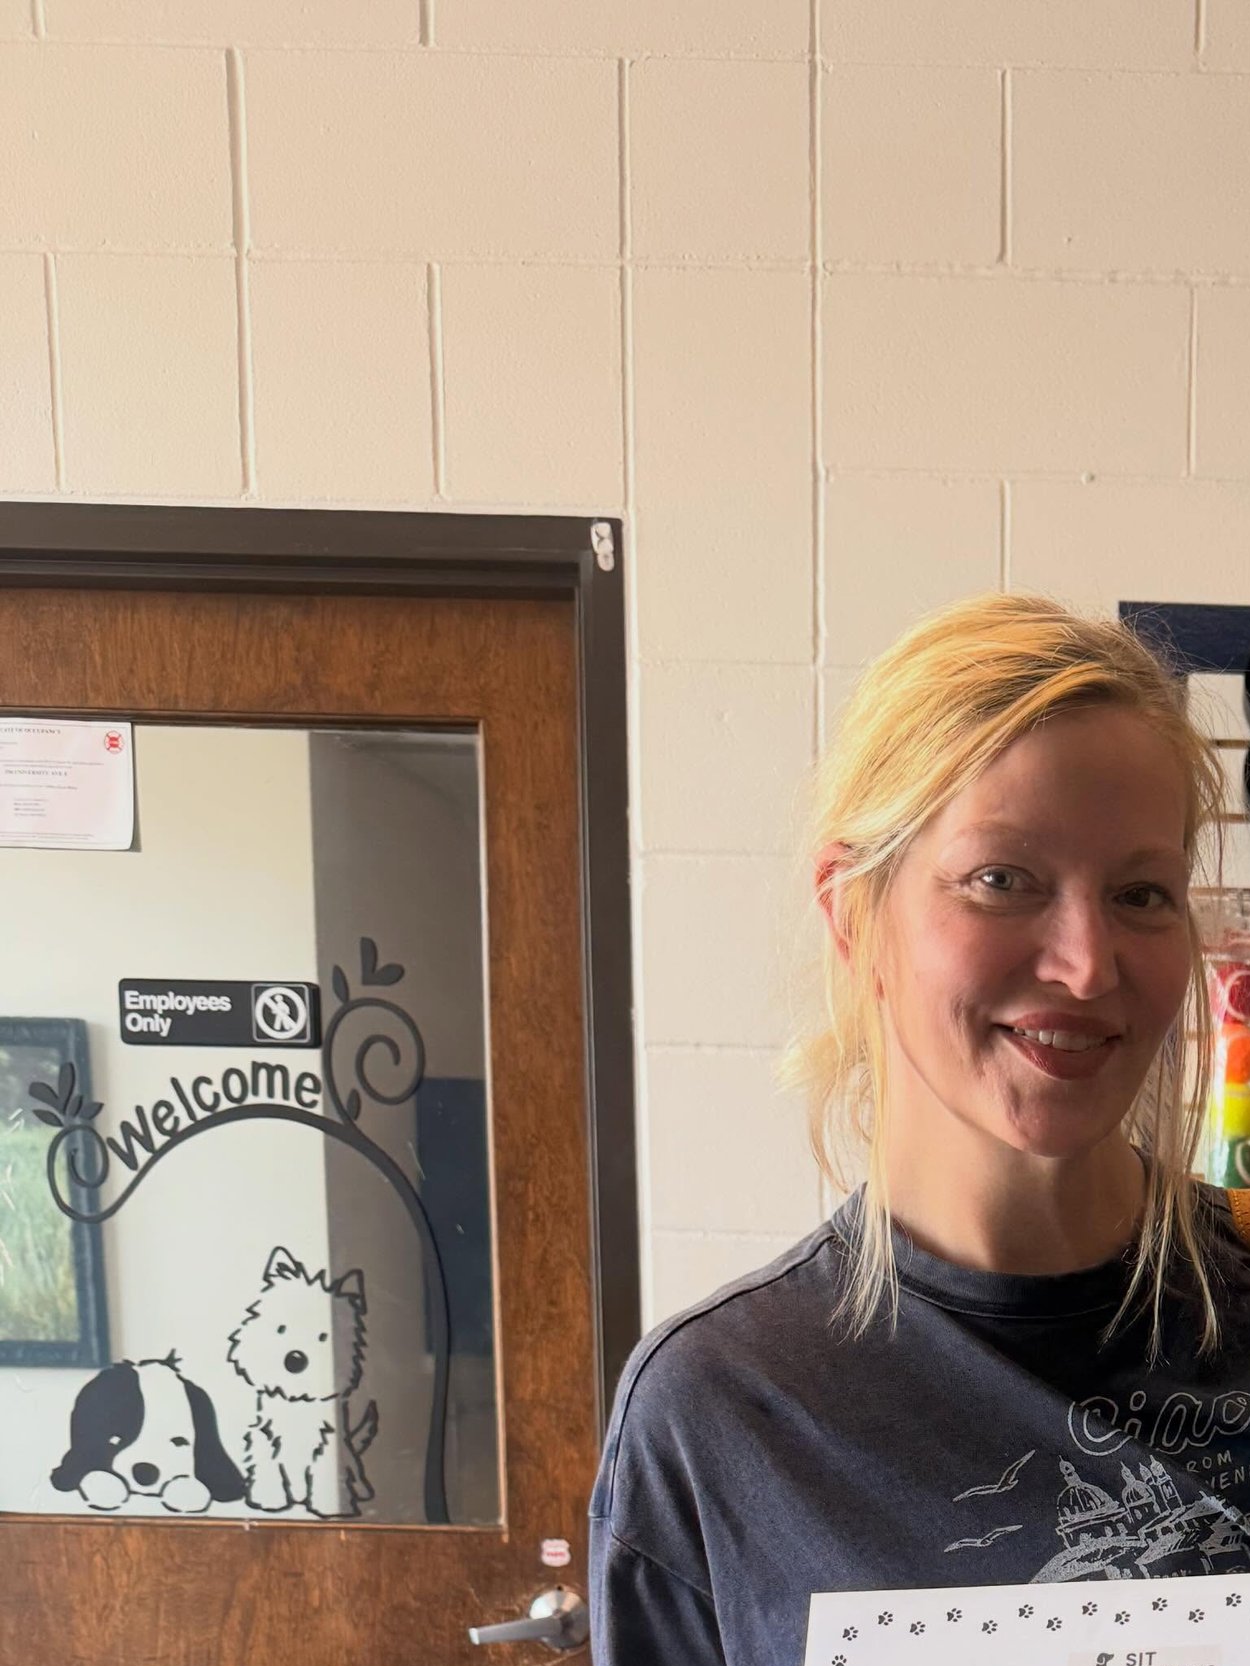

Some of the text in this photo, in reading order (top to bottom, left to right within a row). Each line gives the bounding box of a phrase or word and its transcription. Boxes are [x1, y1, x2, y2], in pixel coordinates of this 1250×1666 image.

[123, 990, 232, 1015] Employees
[125, 1013, 172, 1037] Only
[1186, 1449, 1233, 1473] ROM
[1126, 1651, 1157, 1666] SIT
